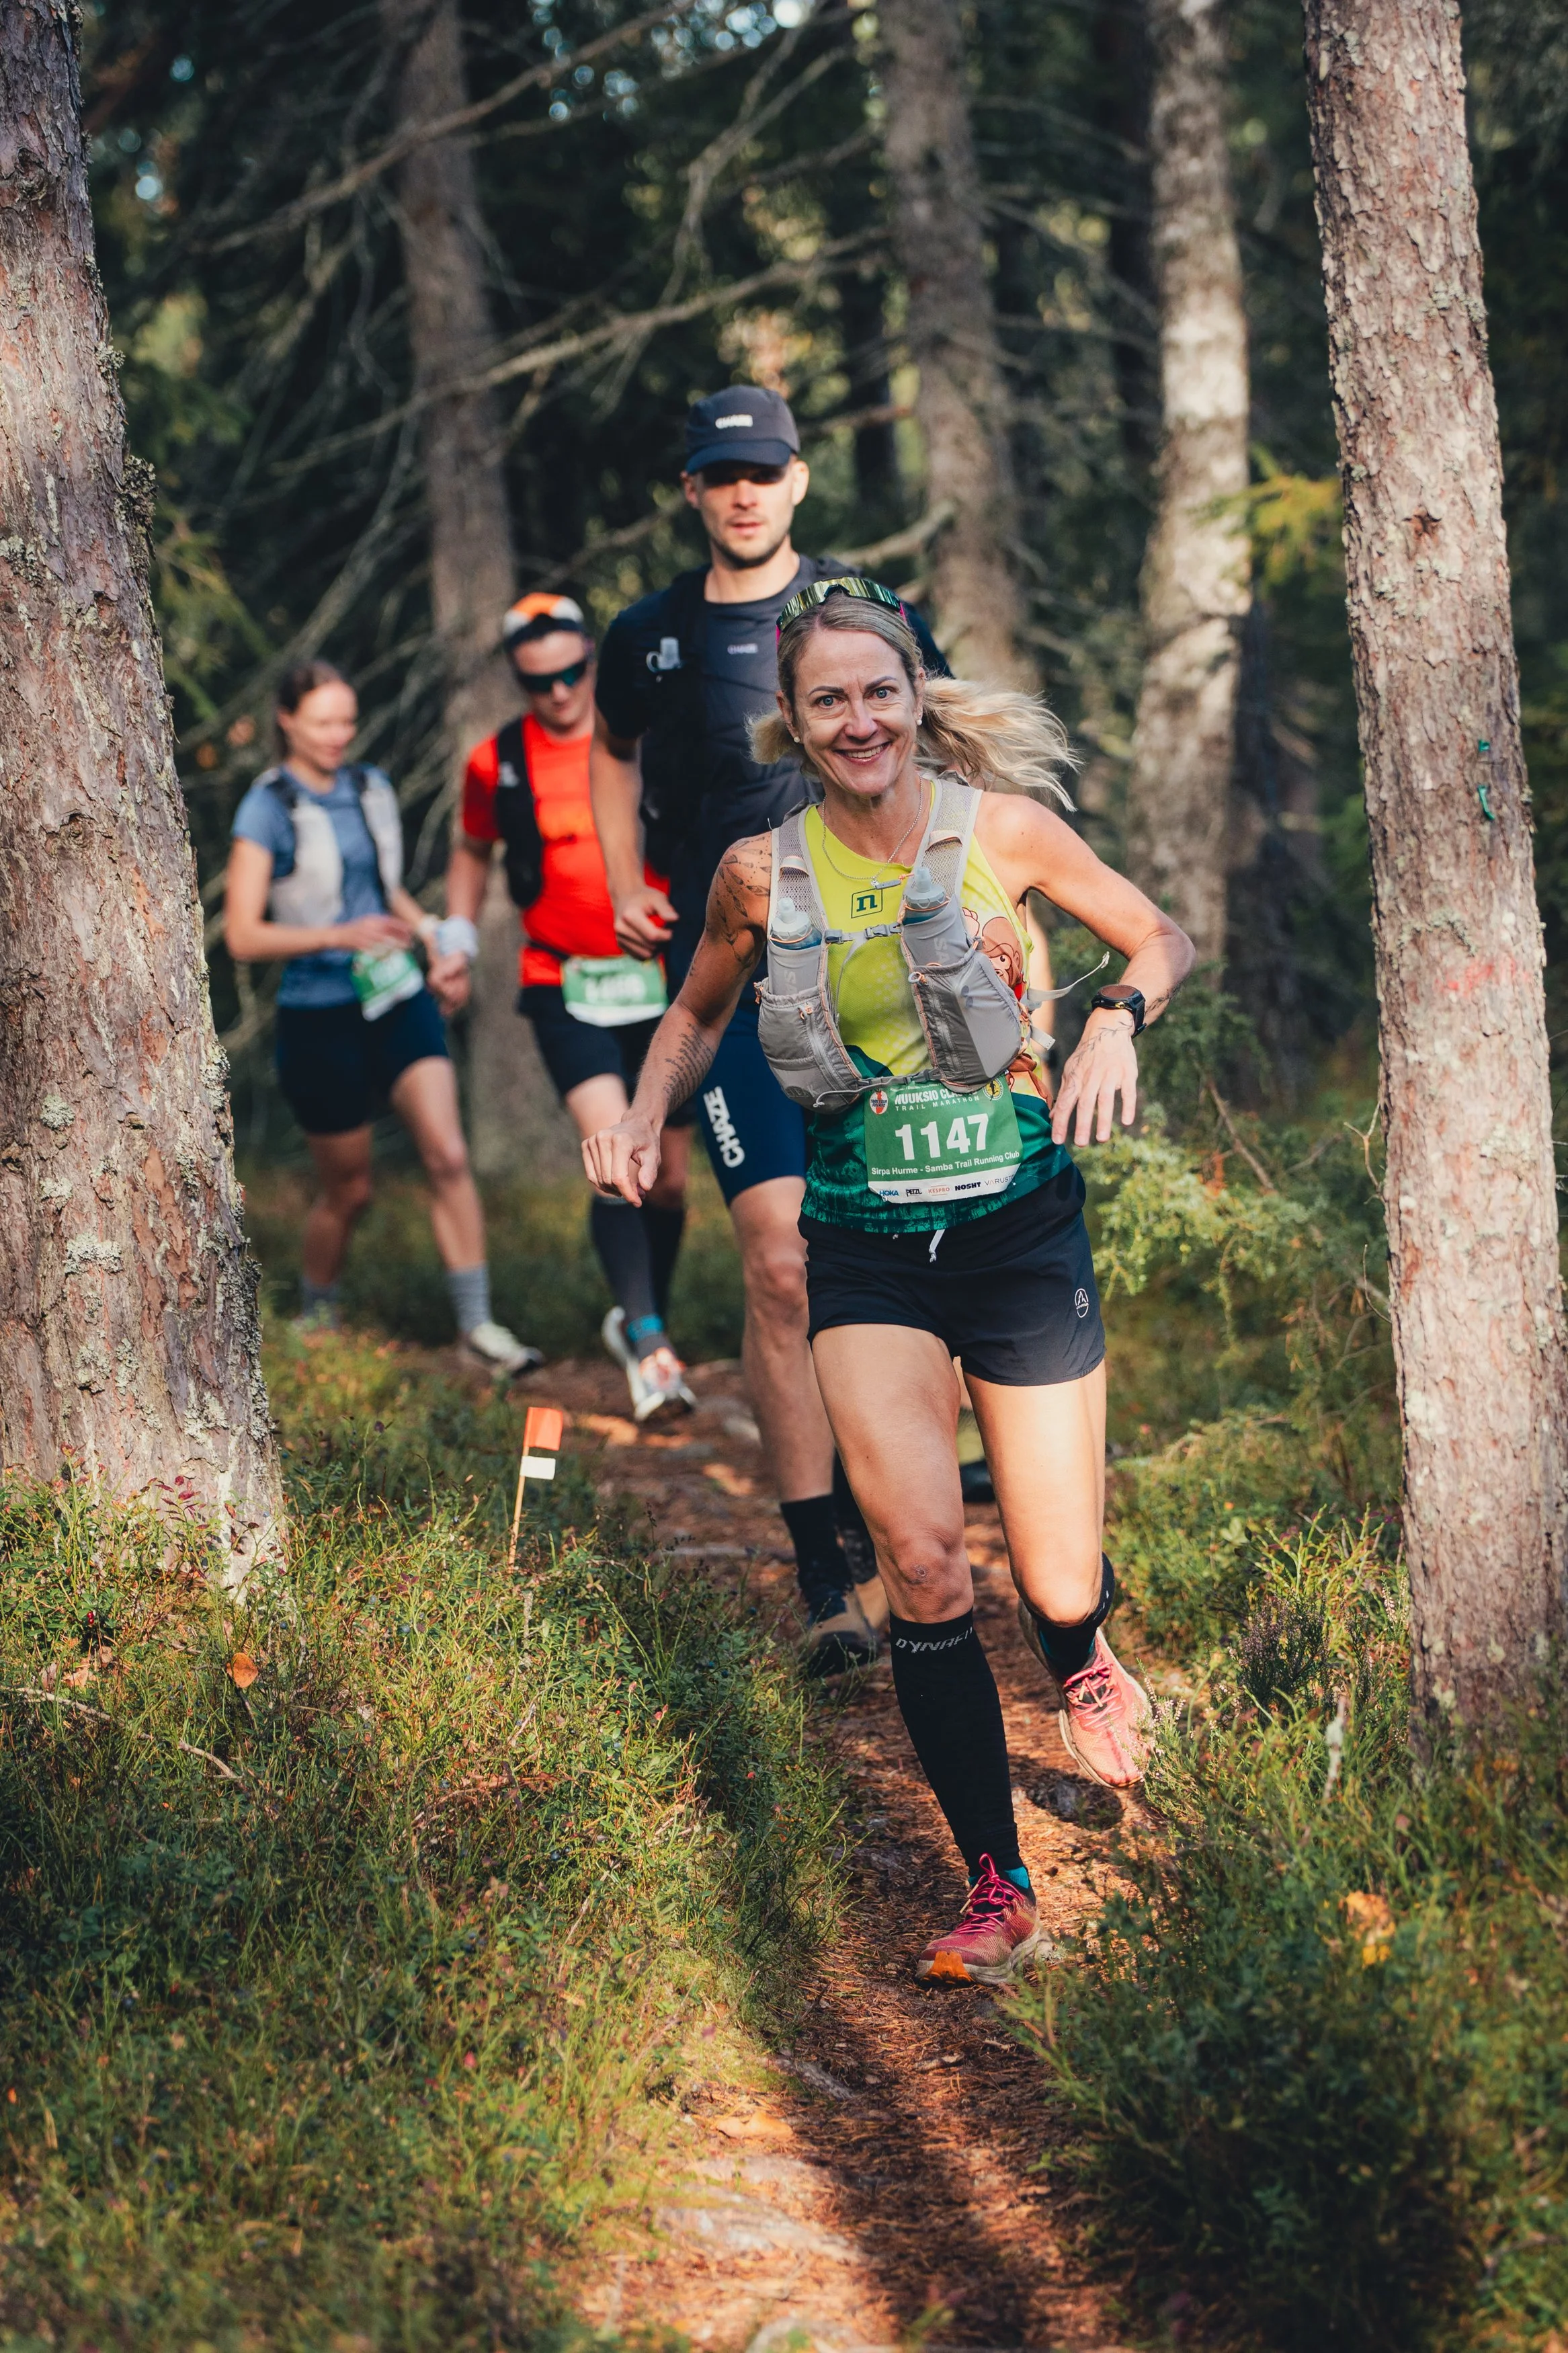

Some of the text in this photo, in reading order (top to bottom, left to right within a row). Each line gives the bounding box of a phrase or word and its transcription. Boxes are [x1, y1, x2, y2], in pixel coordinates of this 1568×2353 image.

[895, 1090, 939, 1105] NUUKSIO
[895, 1096, 979, 1111] TRAIL MARATHON
[895, 1113, 989, 1160] 1147
[871, 1167, 891, 1176] Sirpa
[925, 1163, 953, 1172] Samba
[954, 1159, 973, 1168] Trail
[974, 1154, 1004, 1166] Running
[1004, 1150, 1020, 1160] Club
[906, 1189, 923, 1197] PETZL
[954, 1181, 981, 1191] NOSHT
